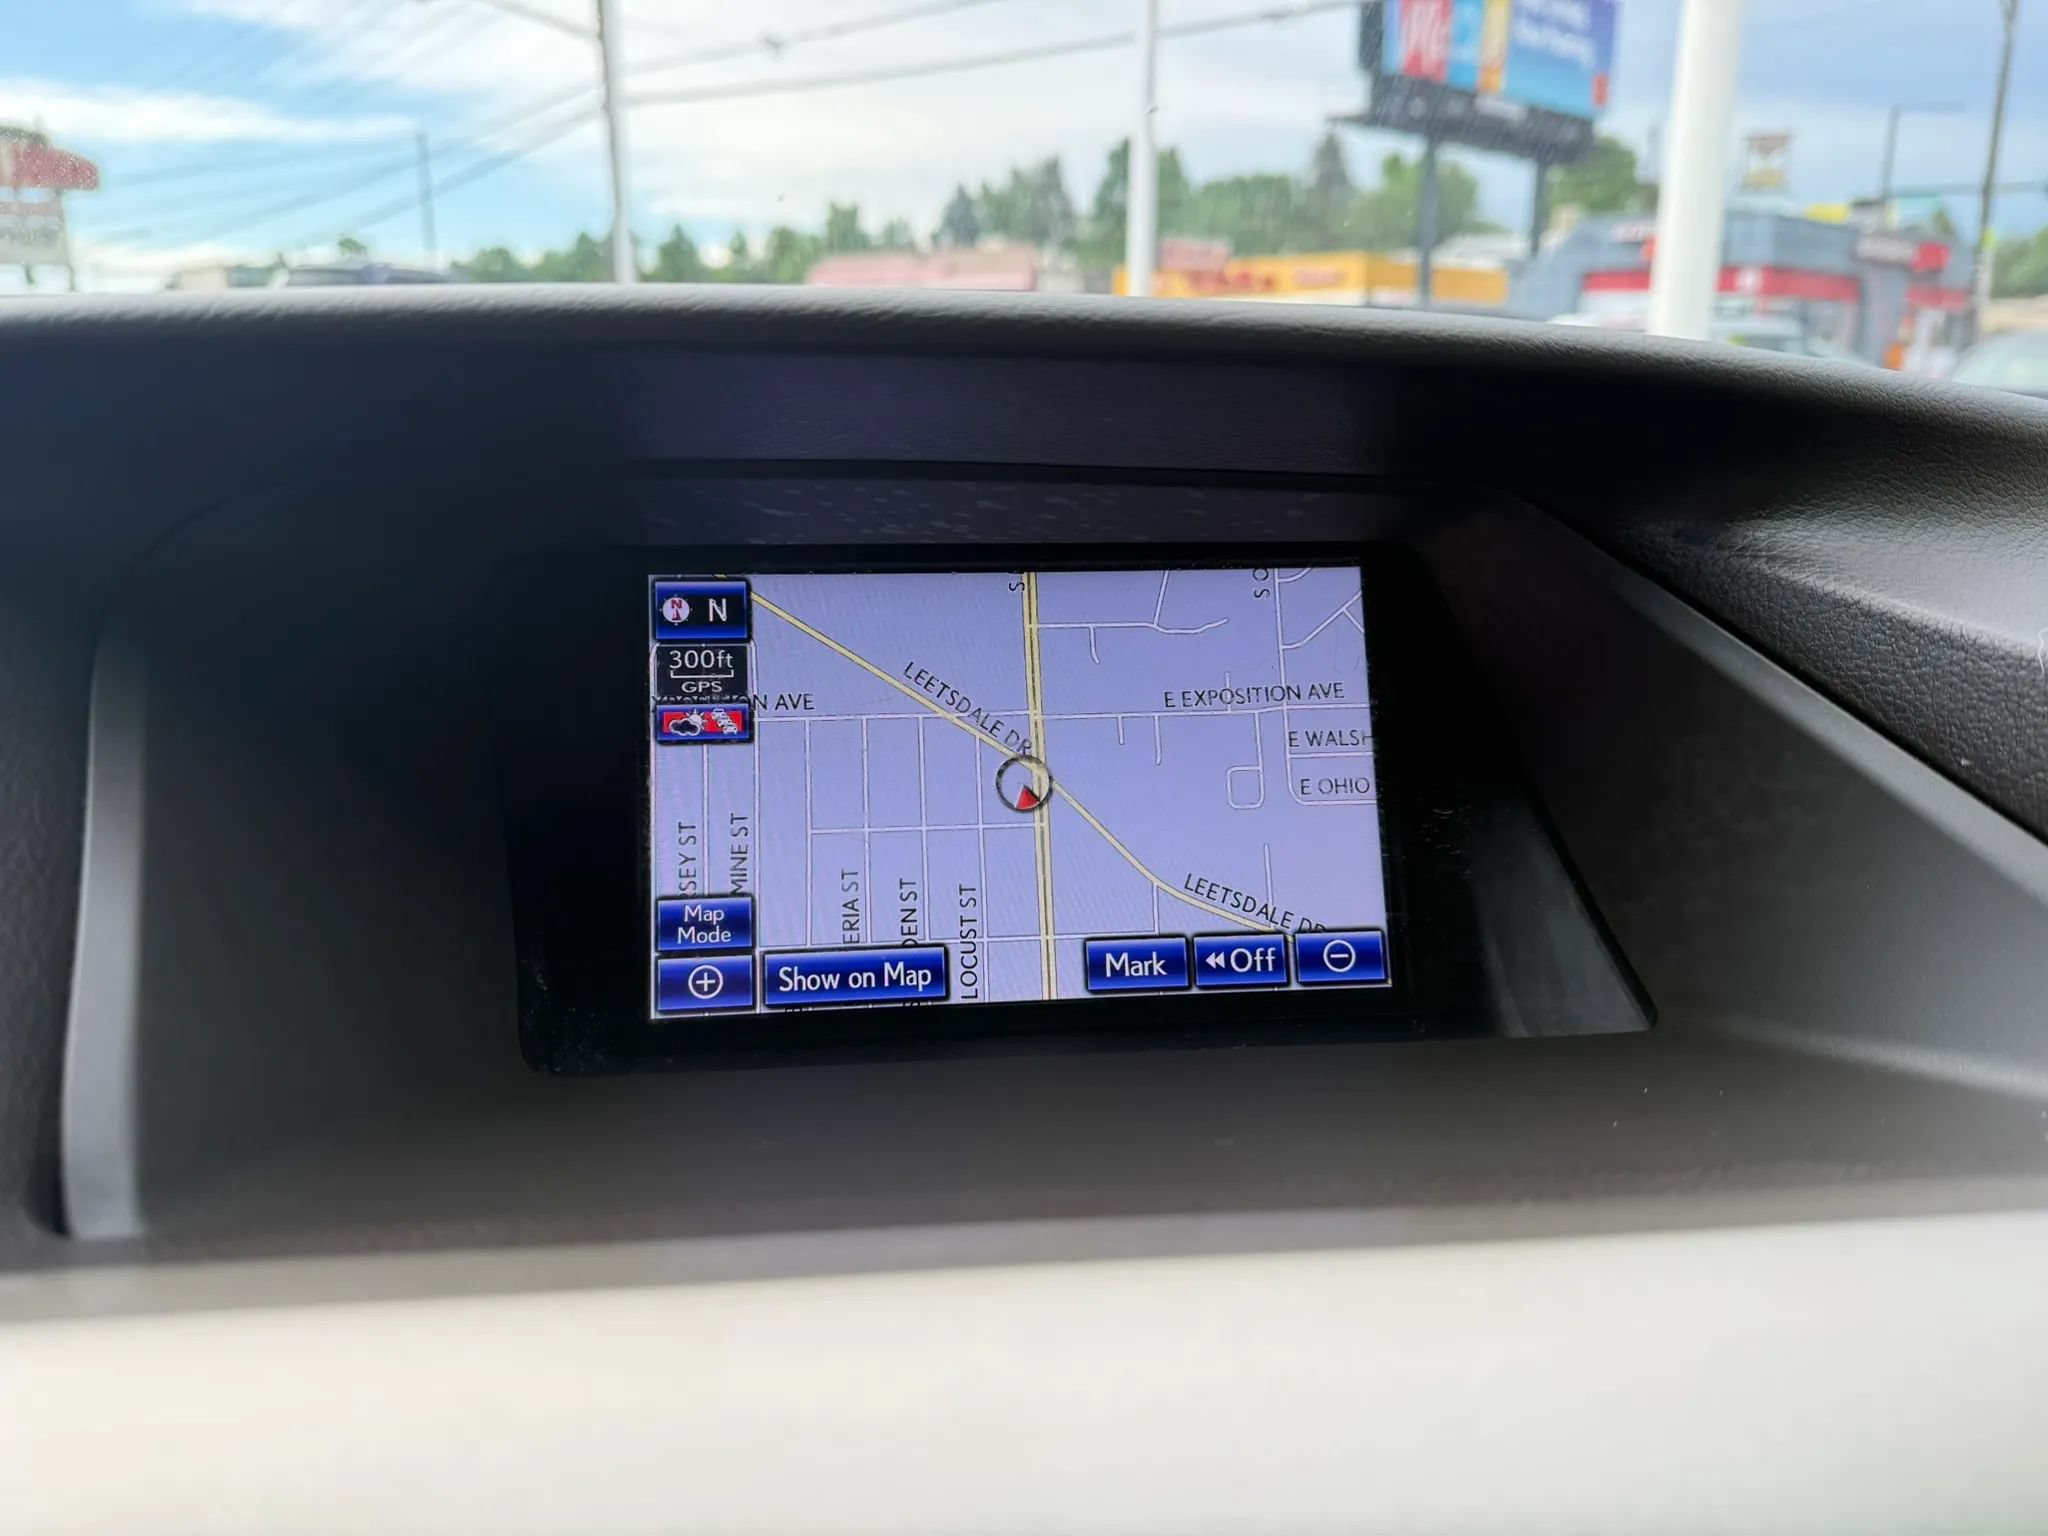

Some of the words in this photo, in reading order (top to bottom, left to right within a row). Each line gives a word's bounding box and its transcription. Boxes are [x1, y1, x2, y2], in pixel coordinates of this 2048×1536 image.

[708, 598, 728, 622] N
[669, 650, 734, 669] 300ft
[681, 681, 723, 693] GPS
[1164, 691, 1176, 708] E
[1182, 684, 1302, 707] EXPOSITION
[1308, 682, 1345, 700] AVE
[775, 693, 815, 711] AVE
[902, 661, 1004, 738] LEETSDALE
[1004, 731, 1032, 755] DR
[1288, 731, 1299, 748] E
[1300, 778, 1312, 795] E
[1318, 777, 1370, 795] OHIO
[678, 821, 697, 846] ST
[730, 813, 749, 837] ST
[841, 869, 859, 893] ST
[899, 878, 918, 902] ST
[959, 884, 977, 908] ST
[1184, 873, 1295, 929] LEETSDALE
[683, 904, 724, 923] Map
[677, 925, 732, 945] Mode
[960, 915, 979, 999] LOCUST
[1105, 951, 1168, 977] Mark
[1230, 947, 1276, 974] Off
[778, 967, 841, 992] Show
[848, 971, 876, 989] on
[883, 961, 932, 991] Map
